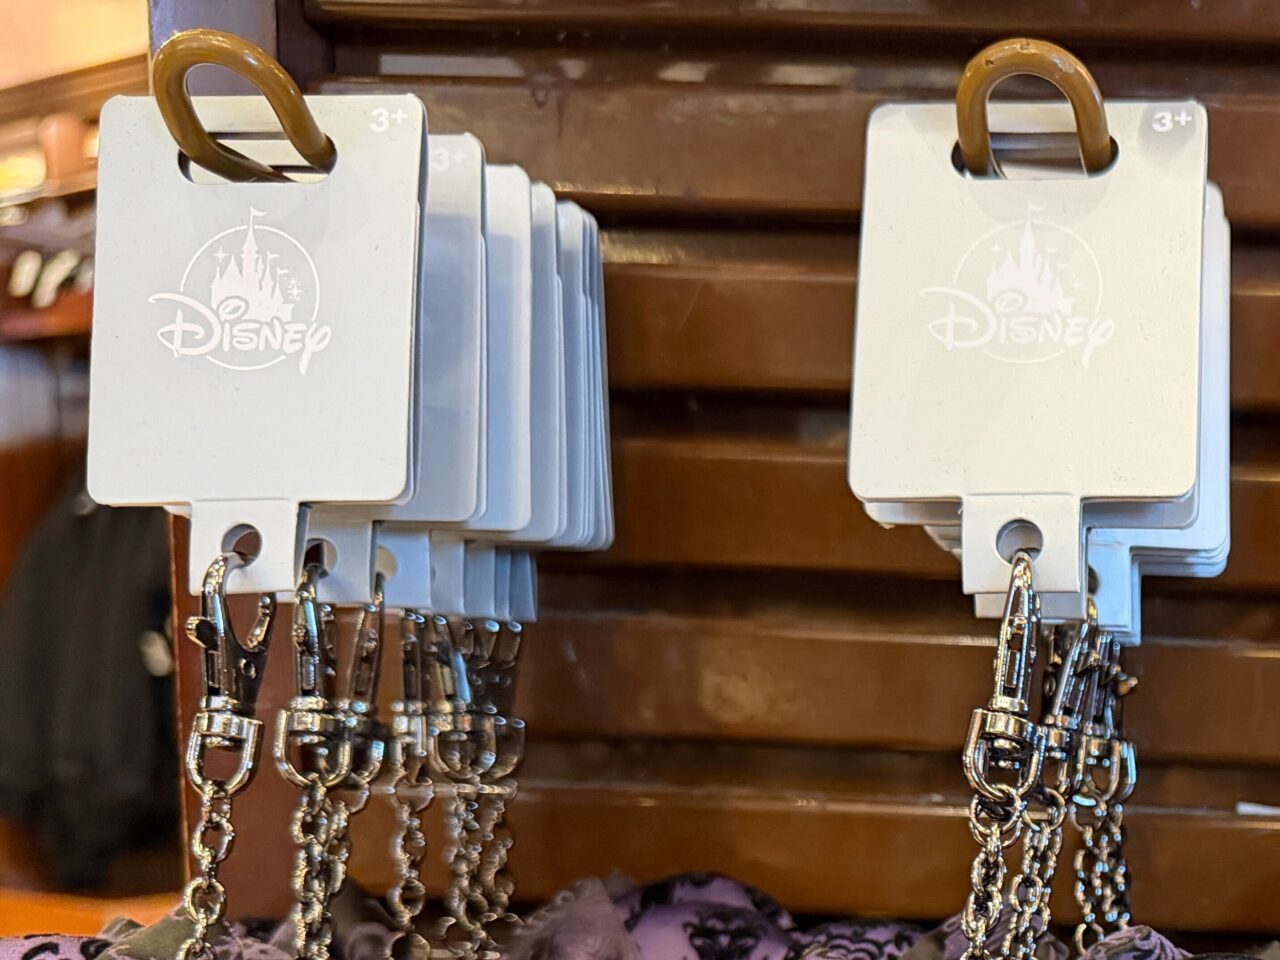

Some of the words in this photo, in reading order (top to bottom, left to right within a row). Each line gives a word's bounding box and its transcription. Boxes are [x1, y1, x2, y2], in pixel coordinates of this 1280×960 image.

[369, 107, 409, 133] 3+
[1151, 110, 1193, 133] 3+
[431, 147, 467, 172] 3+
[149, 292, 332, 375] Disney
[919, 288, 1115, 368] Disney
